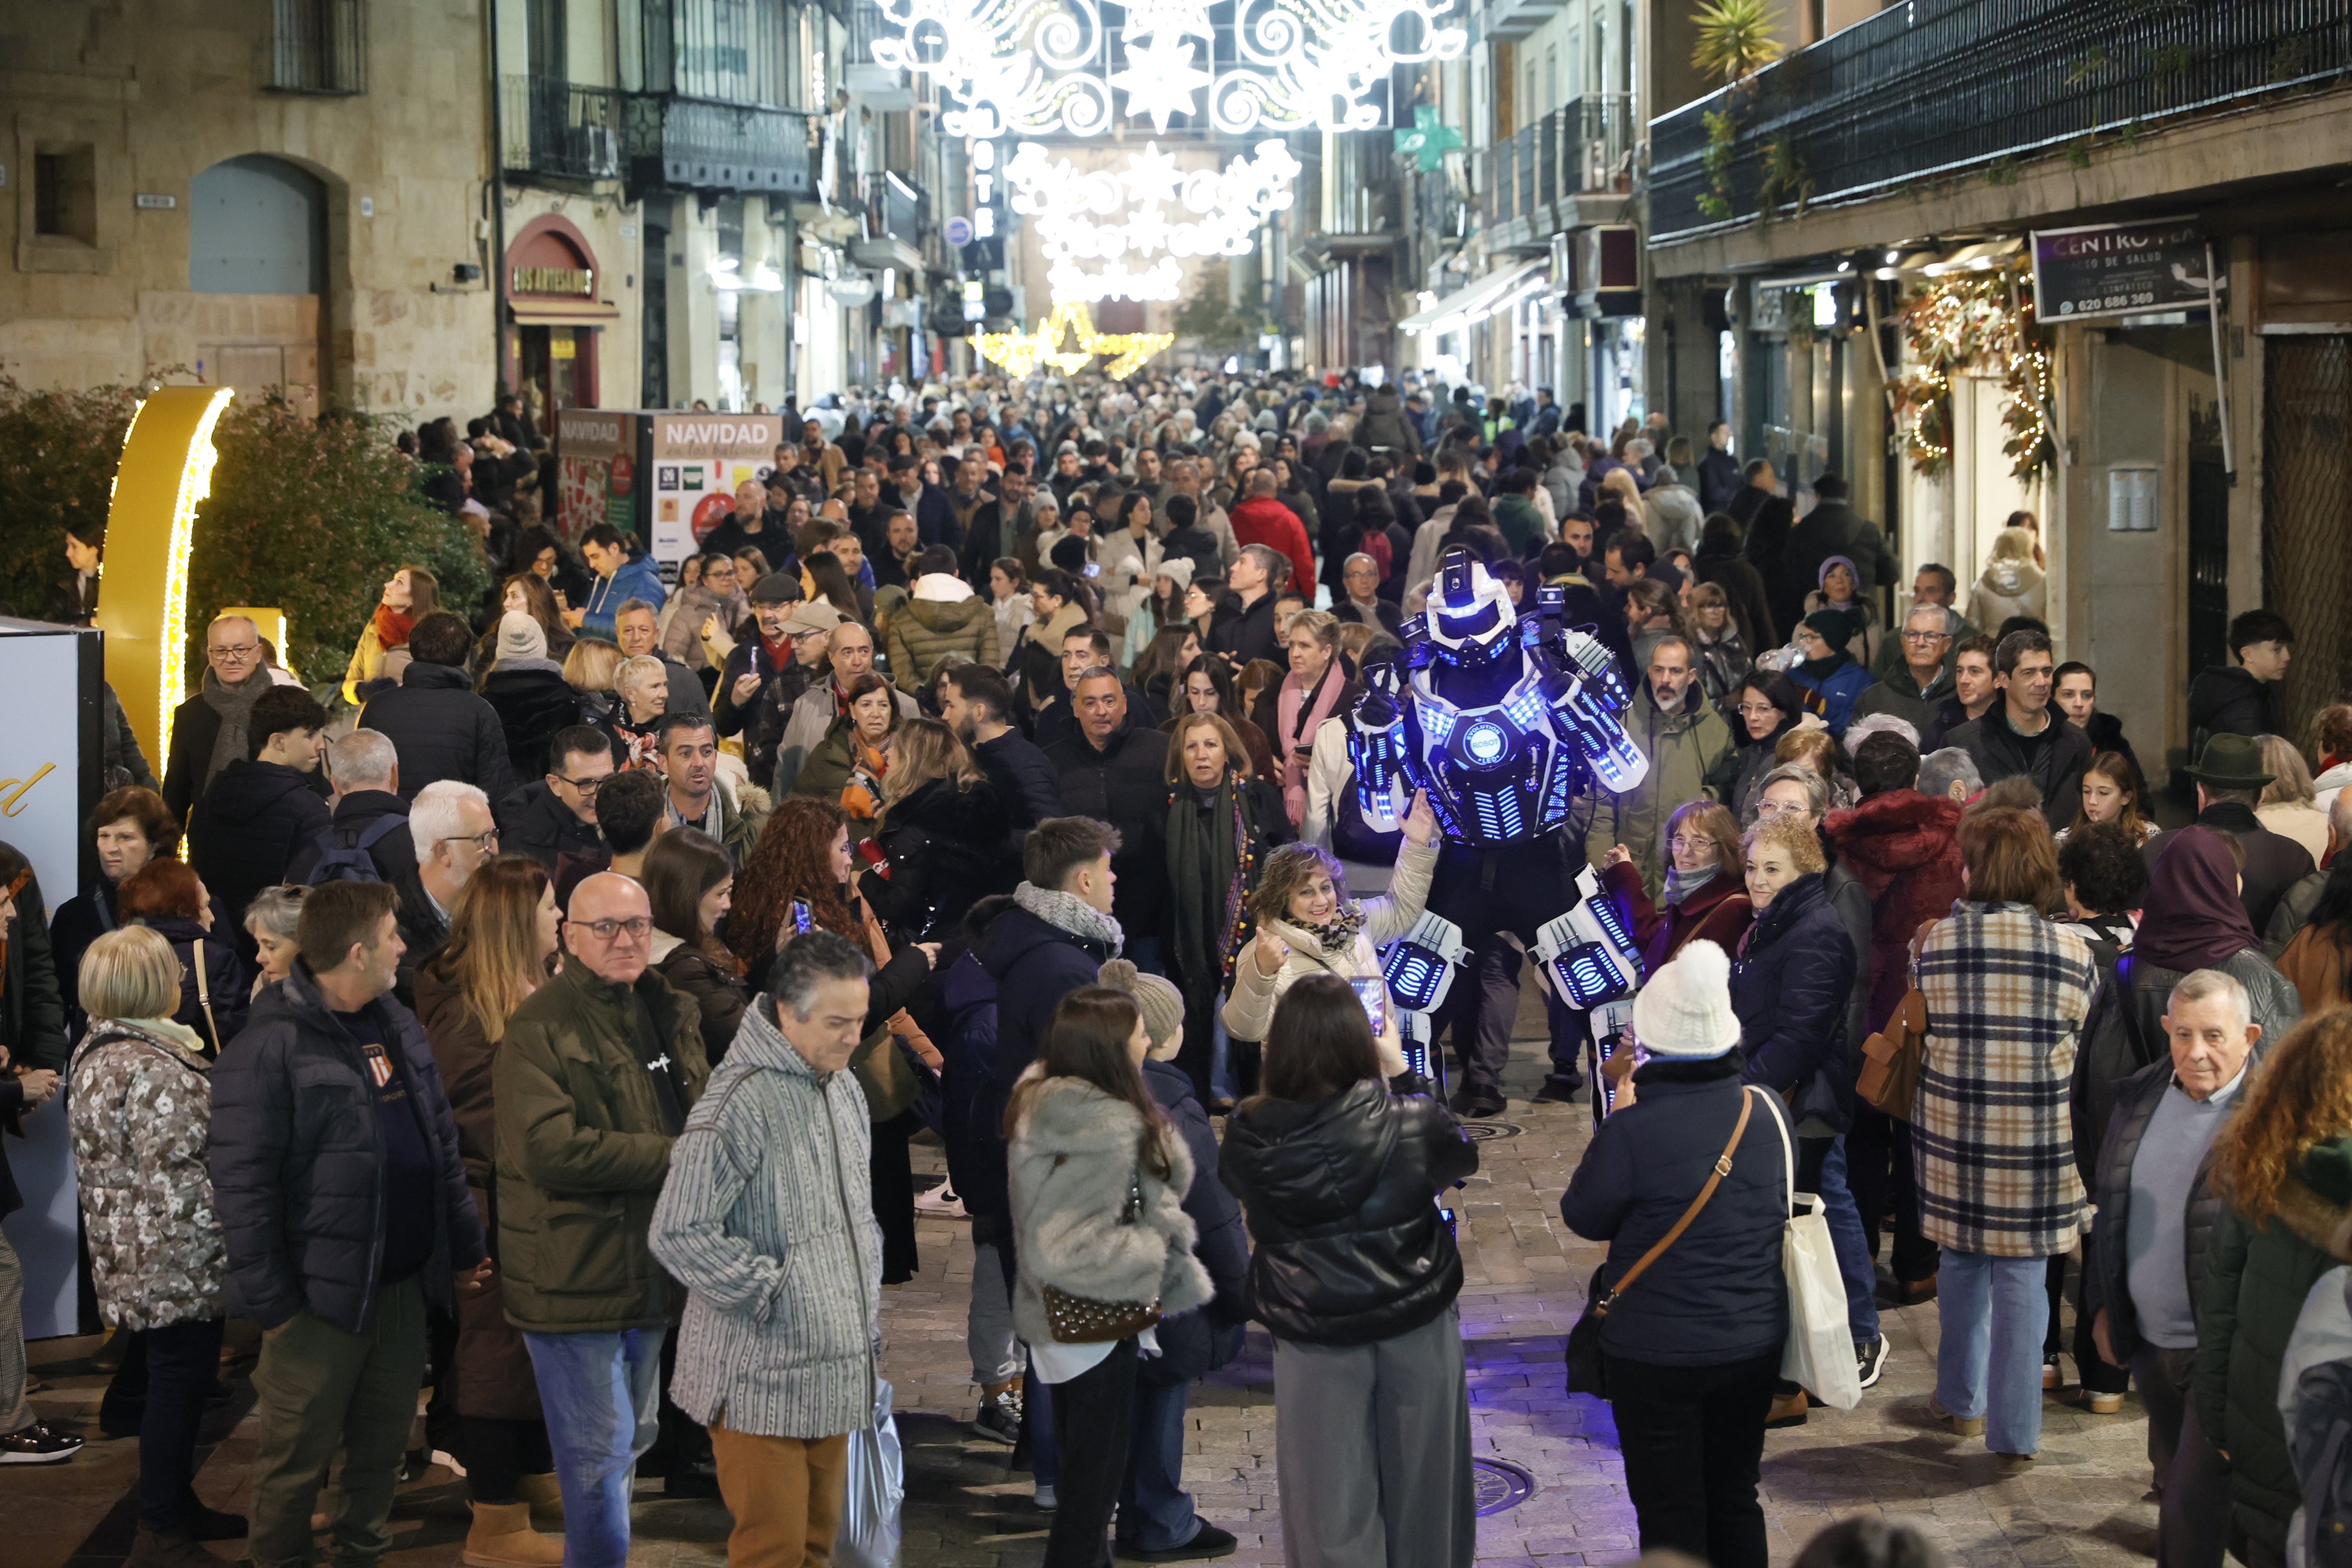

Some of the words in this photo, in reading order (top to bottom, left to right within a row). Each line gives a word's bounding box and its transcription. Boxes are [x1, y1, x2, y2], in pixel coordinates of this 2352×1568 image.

[2053, 235, 2148, 256] CENTRO
[2127, 251, 2161, 264] SALUD
[2077, 298, 2101, 312] 620
[560, 420, 620, 443] NAVIDAD
[666, 423, 769, 444] NAVIDAD
[1466, 724, 1501, 741] EVOLUTION
[1473, 738, 1498, 749] ROBOT
